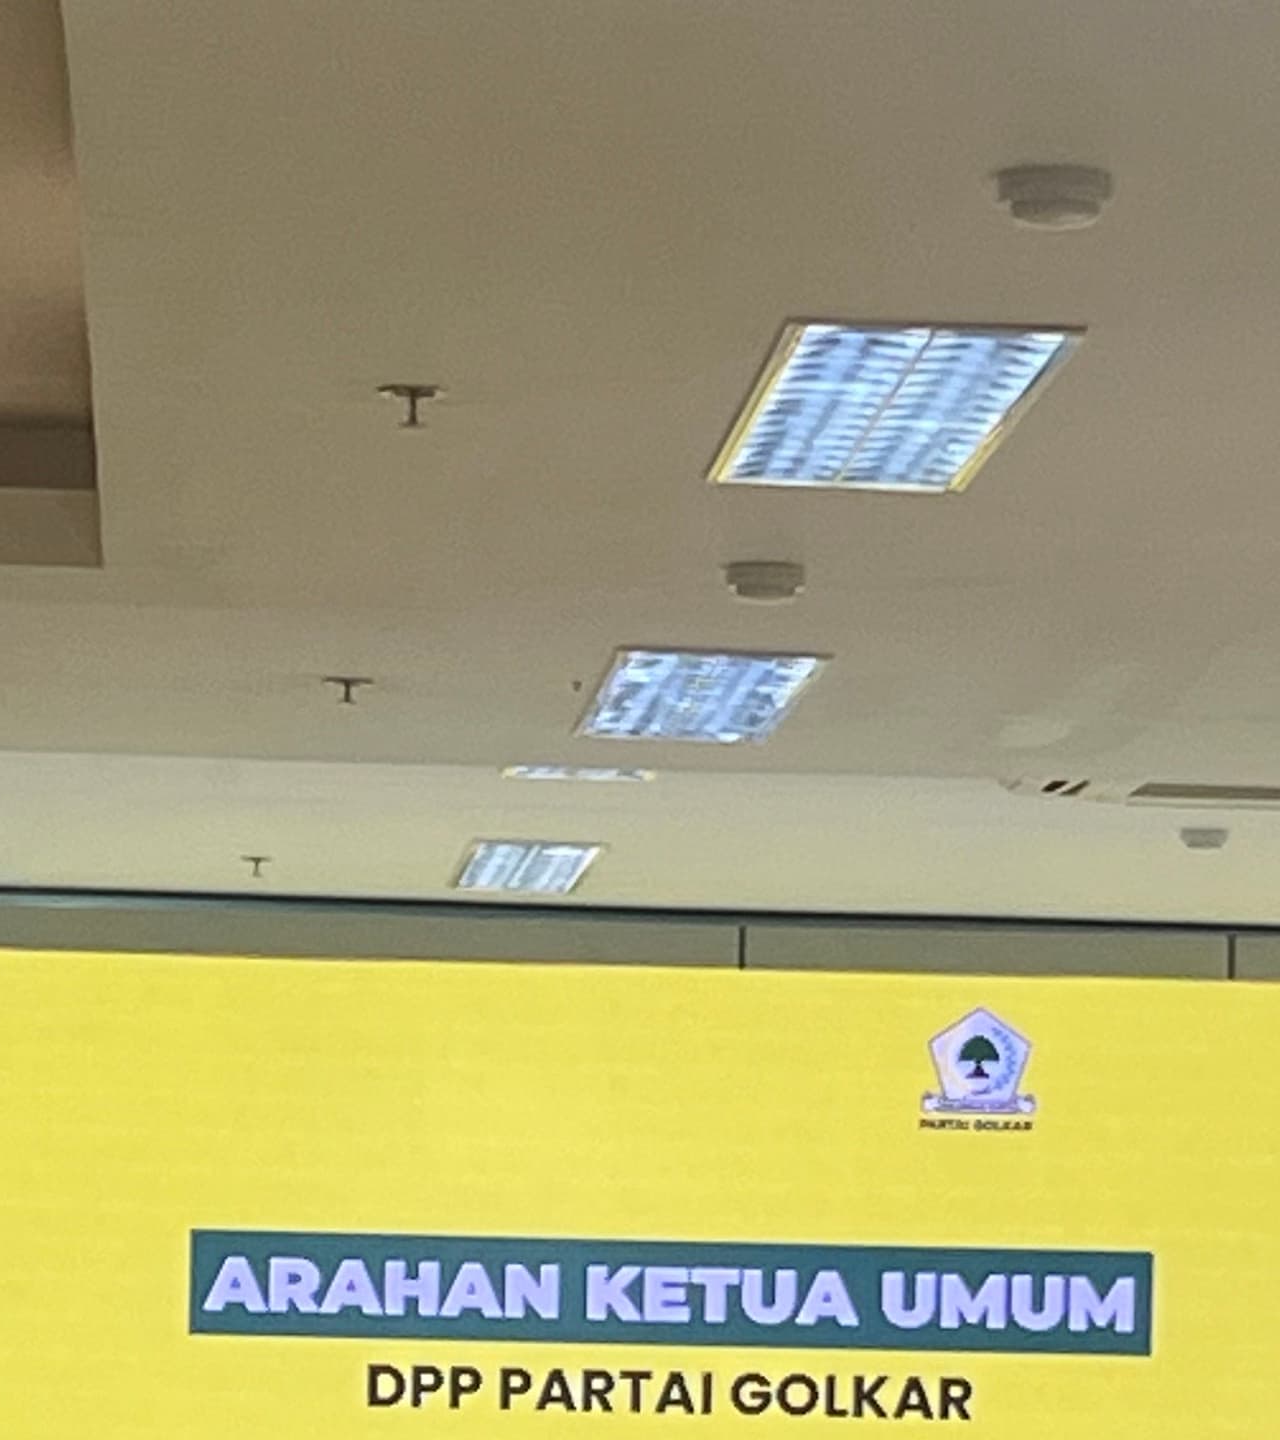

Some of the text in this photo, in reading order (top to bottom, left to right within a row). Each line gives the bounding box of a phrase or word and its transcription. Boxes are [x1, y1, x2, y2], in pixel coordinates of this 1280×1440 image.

[202, 1255, 1136, 1334] ARAHAN KETUA UMUM
[367, 1363, 974, 1421] DPP PARTAI GOLKAR
